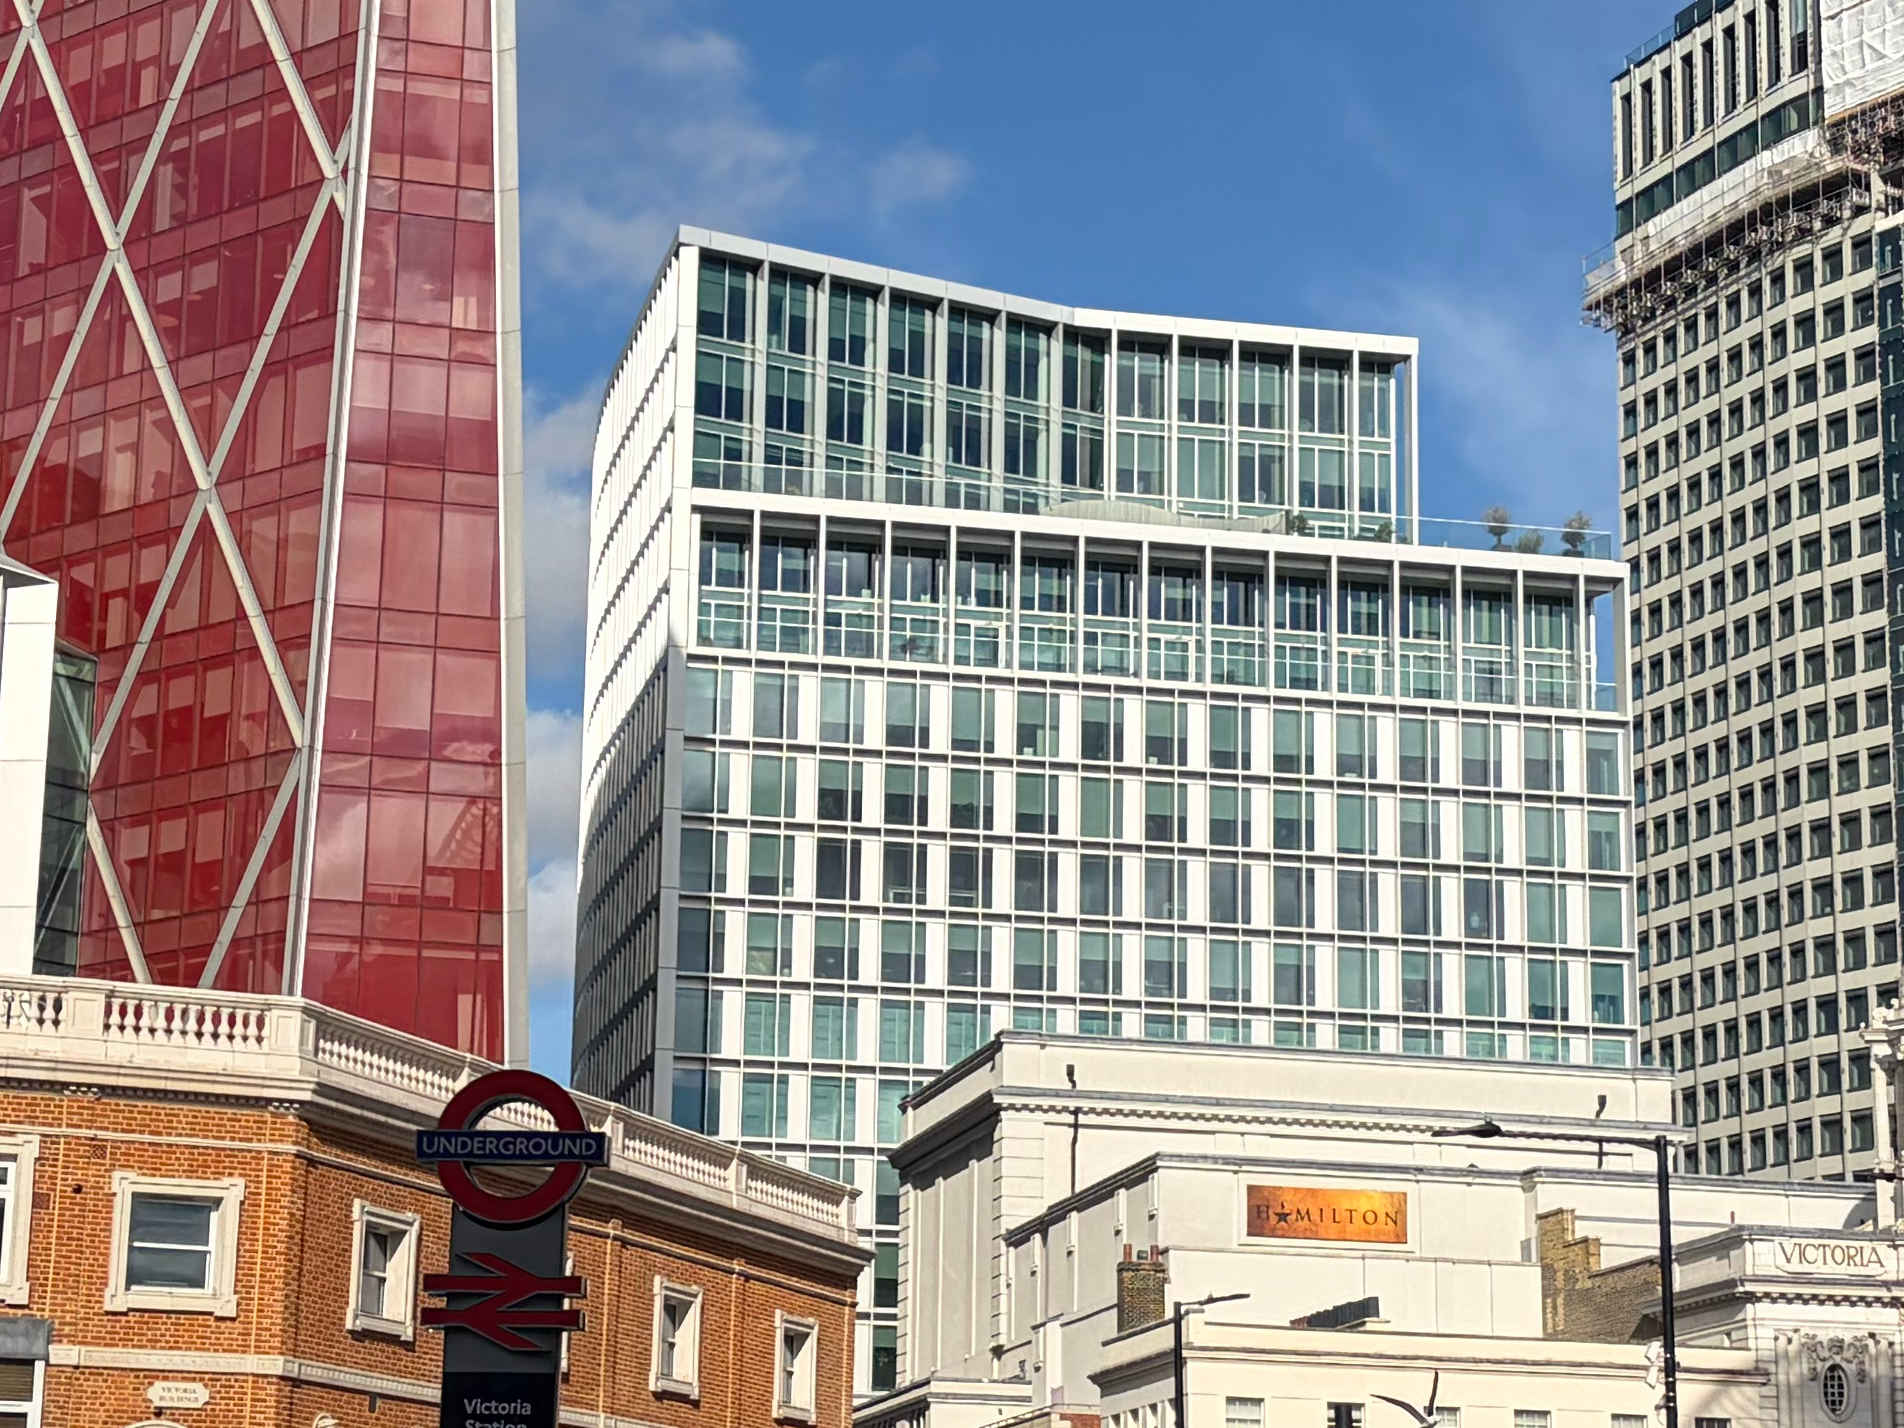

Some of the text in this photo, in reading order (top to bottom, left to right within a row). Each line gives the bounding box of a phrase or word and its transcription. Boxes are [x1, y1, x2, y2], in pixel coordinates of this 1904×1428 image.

[423, 1136, 596, 1156] UNDERGROUND
[1778, 1242, 1886, 1269] VICTORIA
[463, 1398, 532, 1415] Victoria
